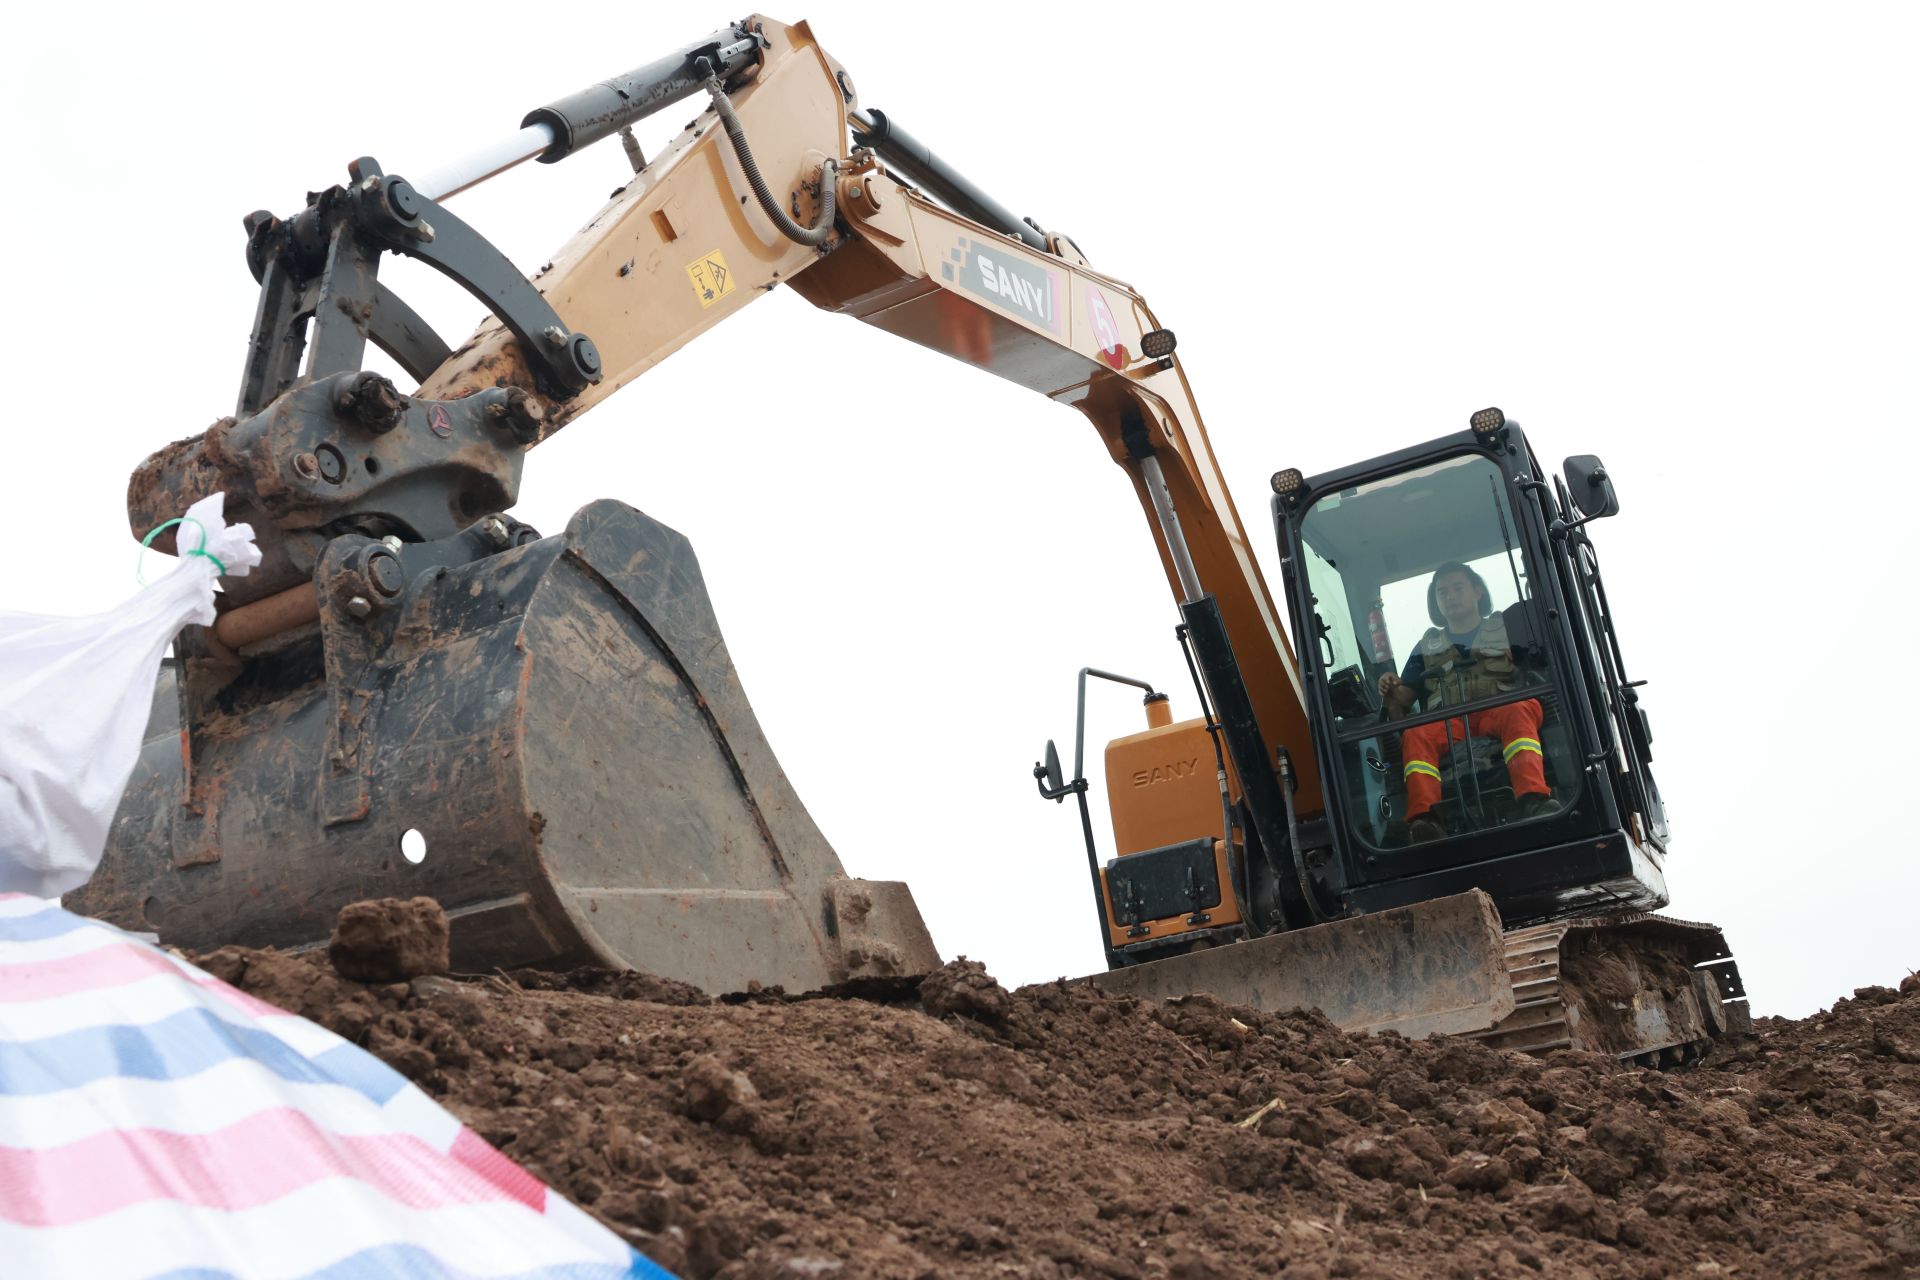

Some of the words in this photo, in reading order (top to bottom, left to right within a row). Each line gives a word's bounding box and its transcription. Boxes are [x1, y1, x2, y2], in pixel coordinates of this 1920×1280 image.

[978, 255, 1044, 318] SANY
[1092, 298, 1116, 355] 5
[1132, 758, 1199, 789] SANY
